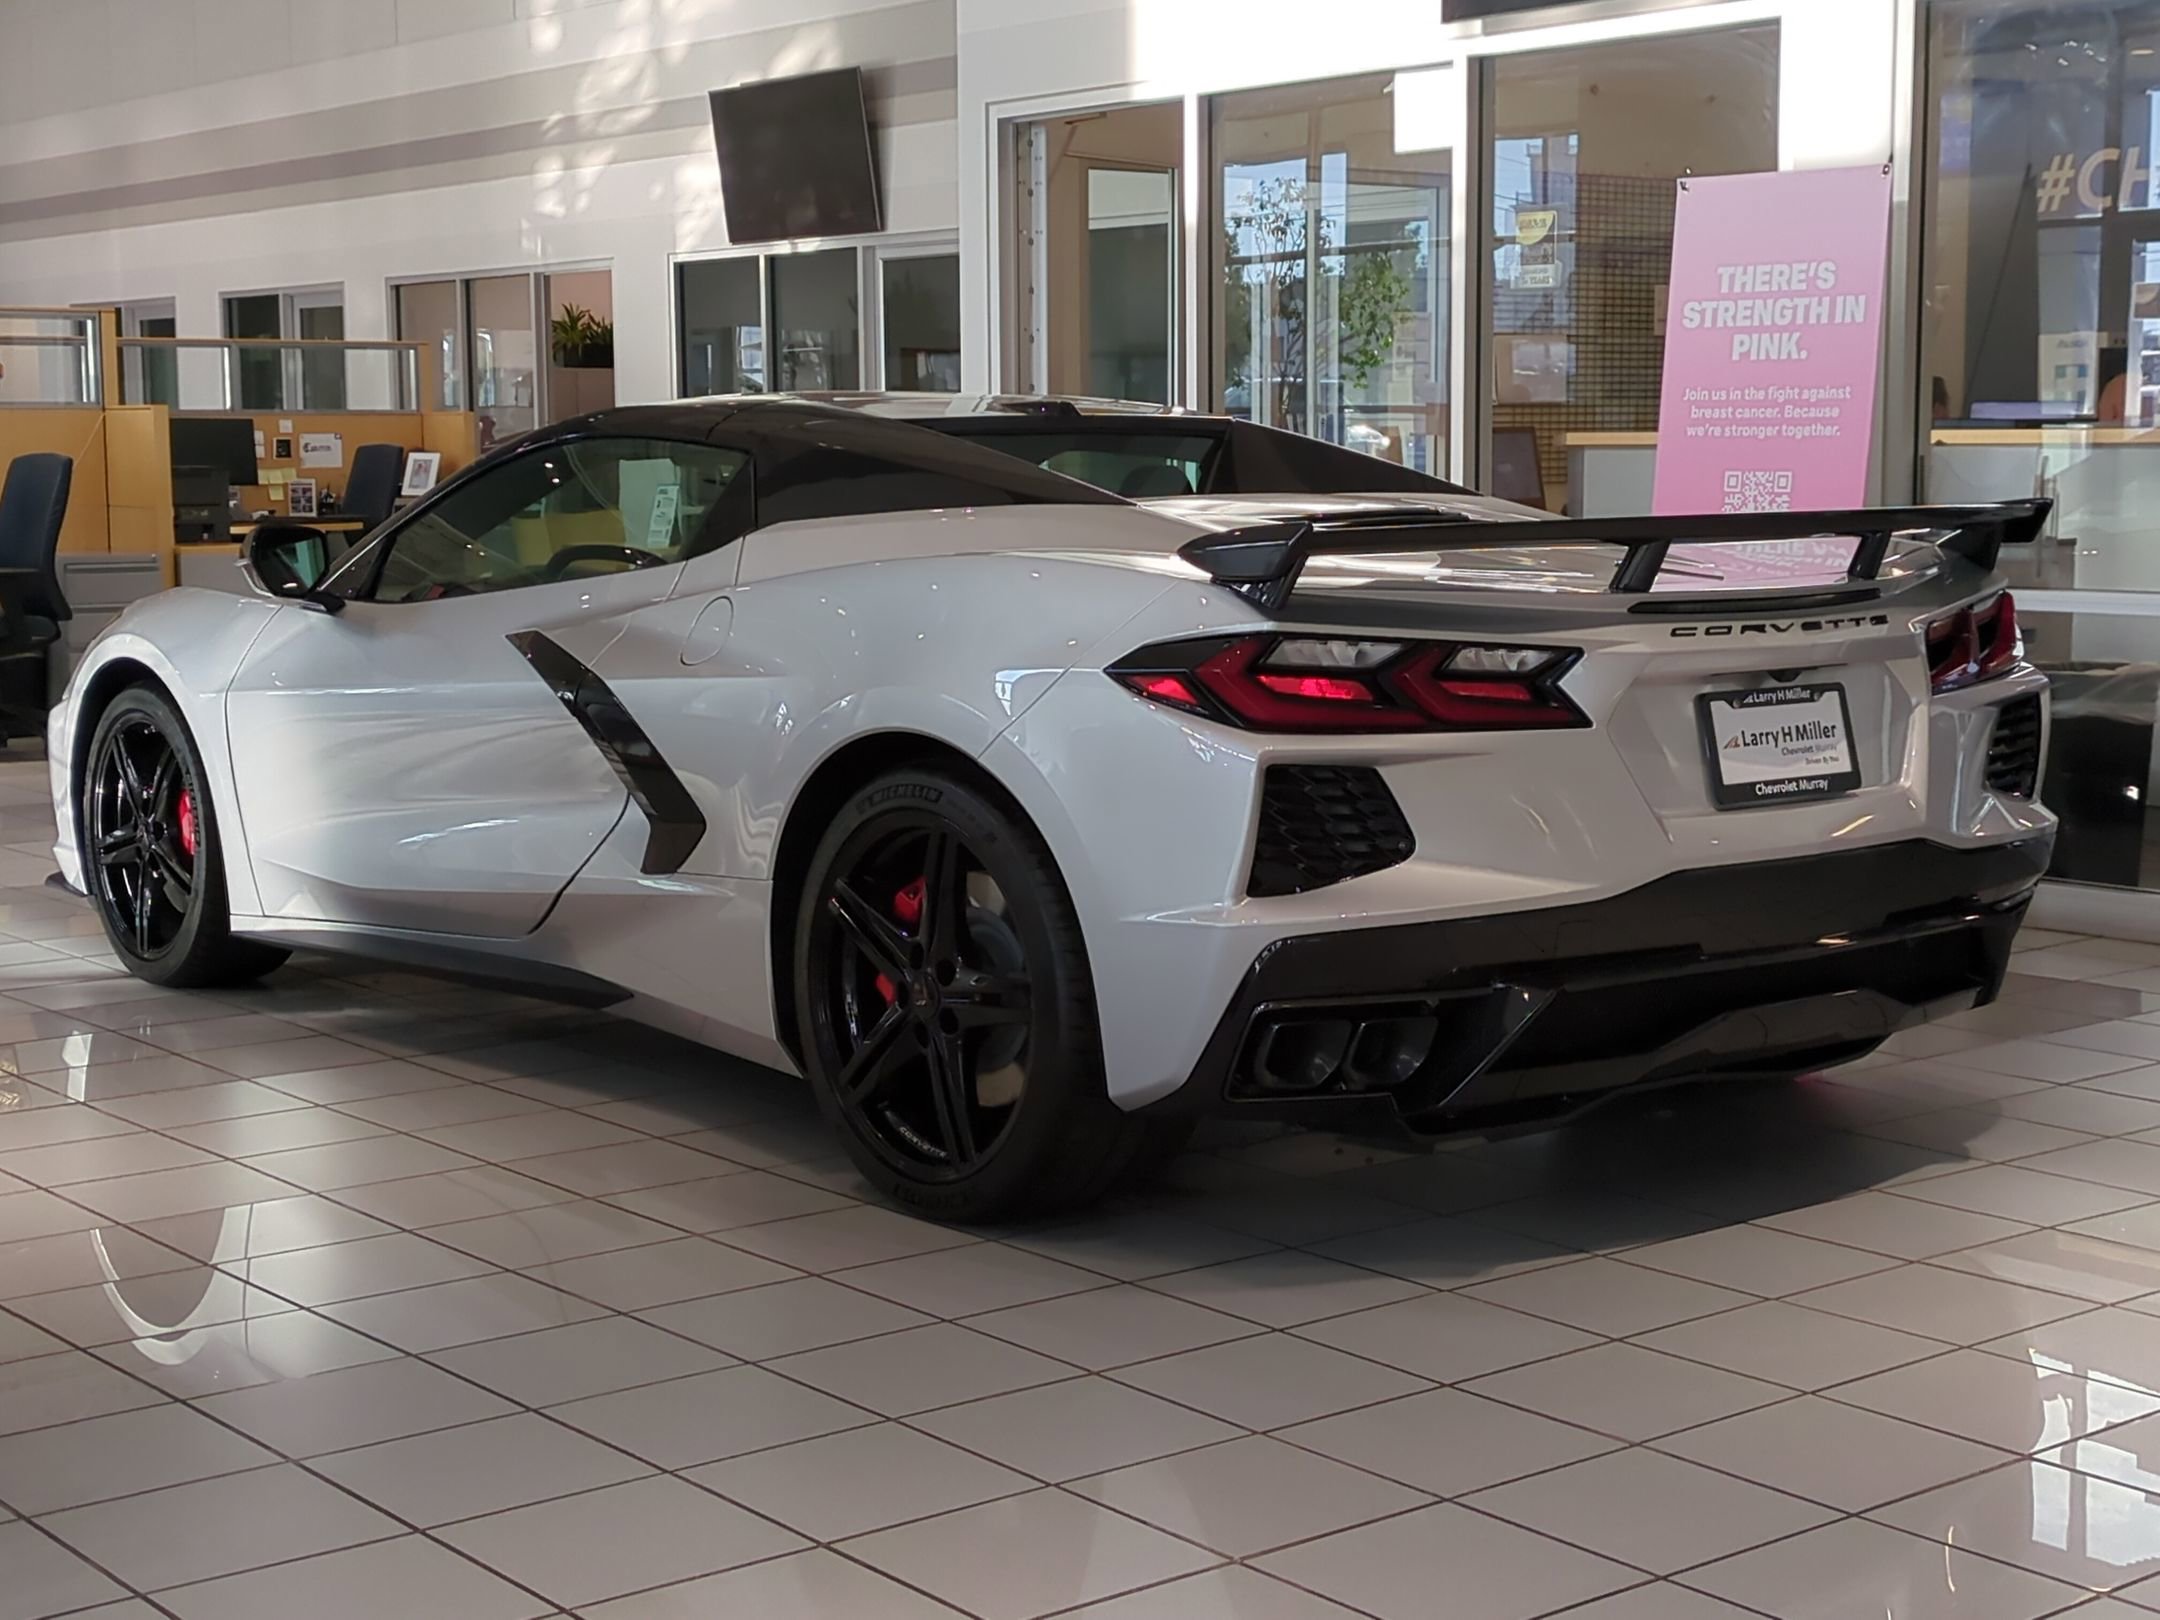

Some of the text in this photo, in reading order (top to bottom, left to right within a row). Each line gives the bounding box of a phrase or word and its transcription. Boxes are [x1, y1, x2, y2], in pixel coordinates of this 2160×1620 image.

[1716, 260, 1837, 294] THERE'S
[1681, 294, 1866, 329] STRENGTH IN
[1731, 331, 1808, 361] PINK.
[1683, 385, 1851, 403] Join us in the fight against
[1690, 404, 1840, 419] breast cancer. Because
[1686, 422, 1841, 440] we're stronger together.
[1670, 614, 1889, 638] CORVETTE
[1753, 691, 1778, 704] Larry
[1777, 689, 1786, 701] H
[1741, 720, 1837, 749] Larry H Miller
[870, 784, 941, 807] MICHELIN
[1755, 778, 1829, 796] Chevrolet Murray
